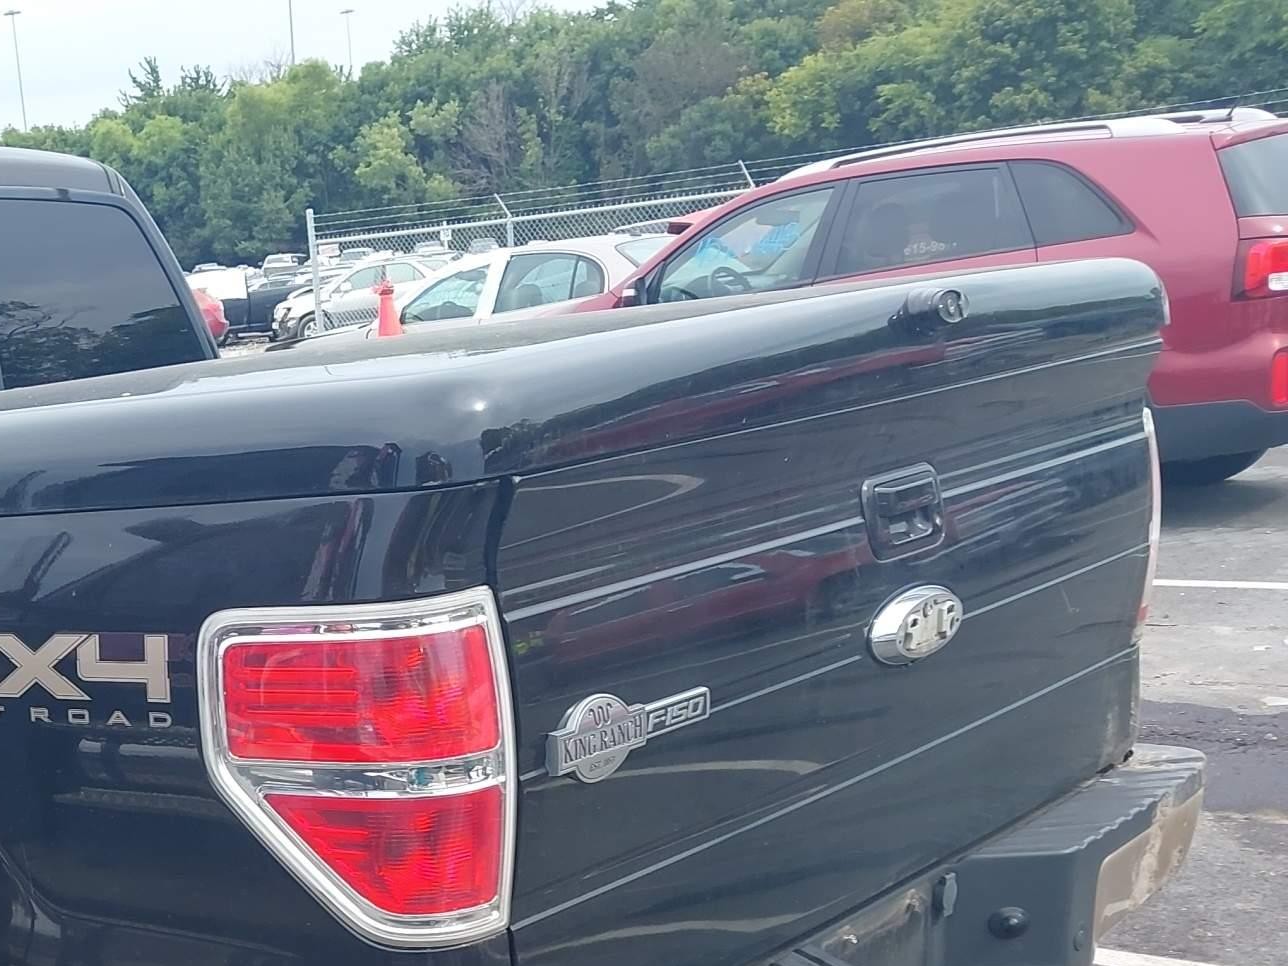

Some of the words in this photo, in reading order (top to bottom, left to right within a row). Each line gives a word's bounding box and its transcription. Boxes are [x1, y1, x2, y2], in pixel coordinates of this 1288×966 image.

[29, 706, 173, 729] ROAD
[562, 732, 597, 764] KING
[600, 714, 644, 751] RANCH
